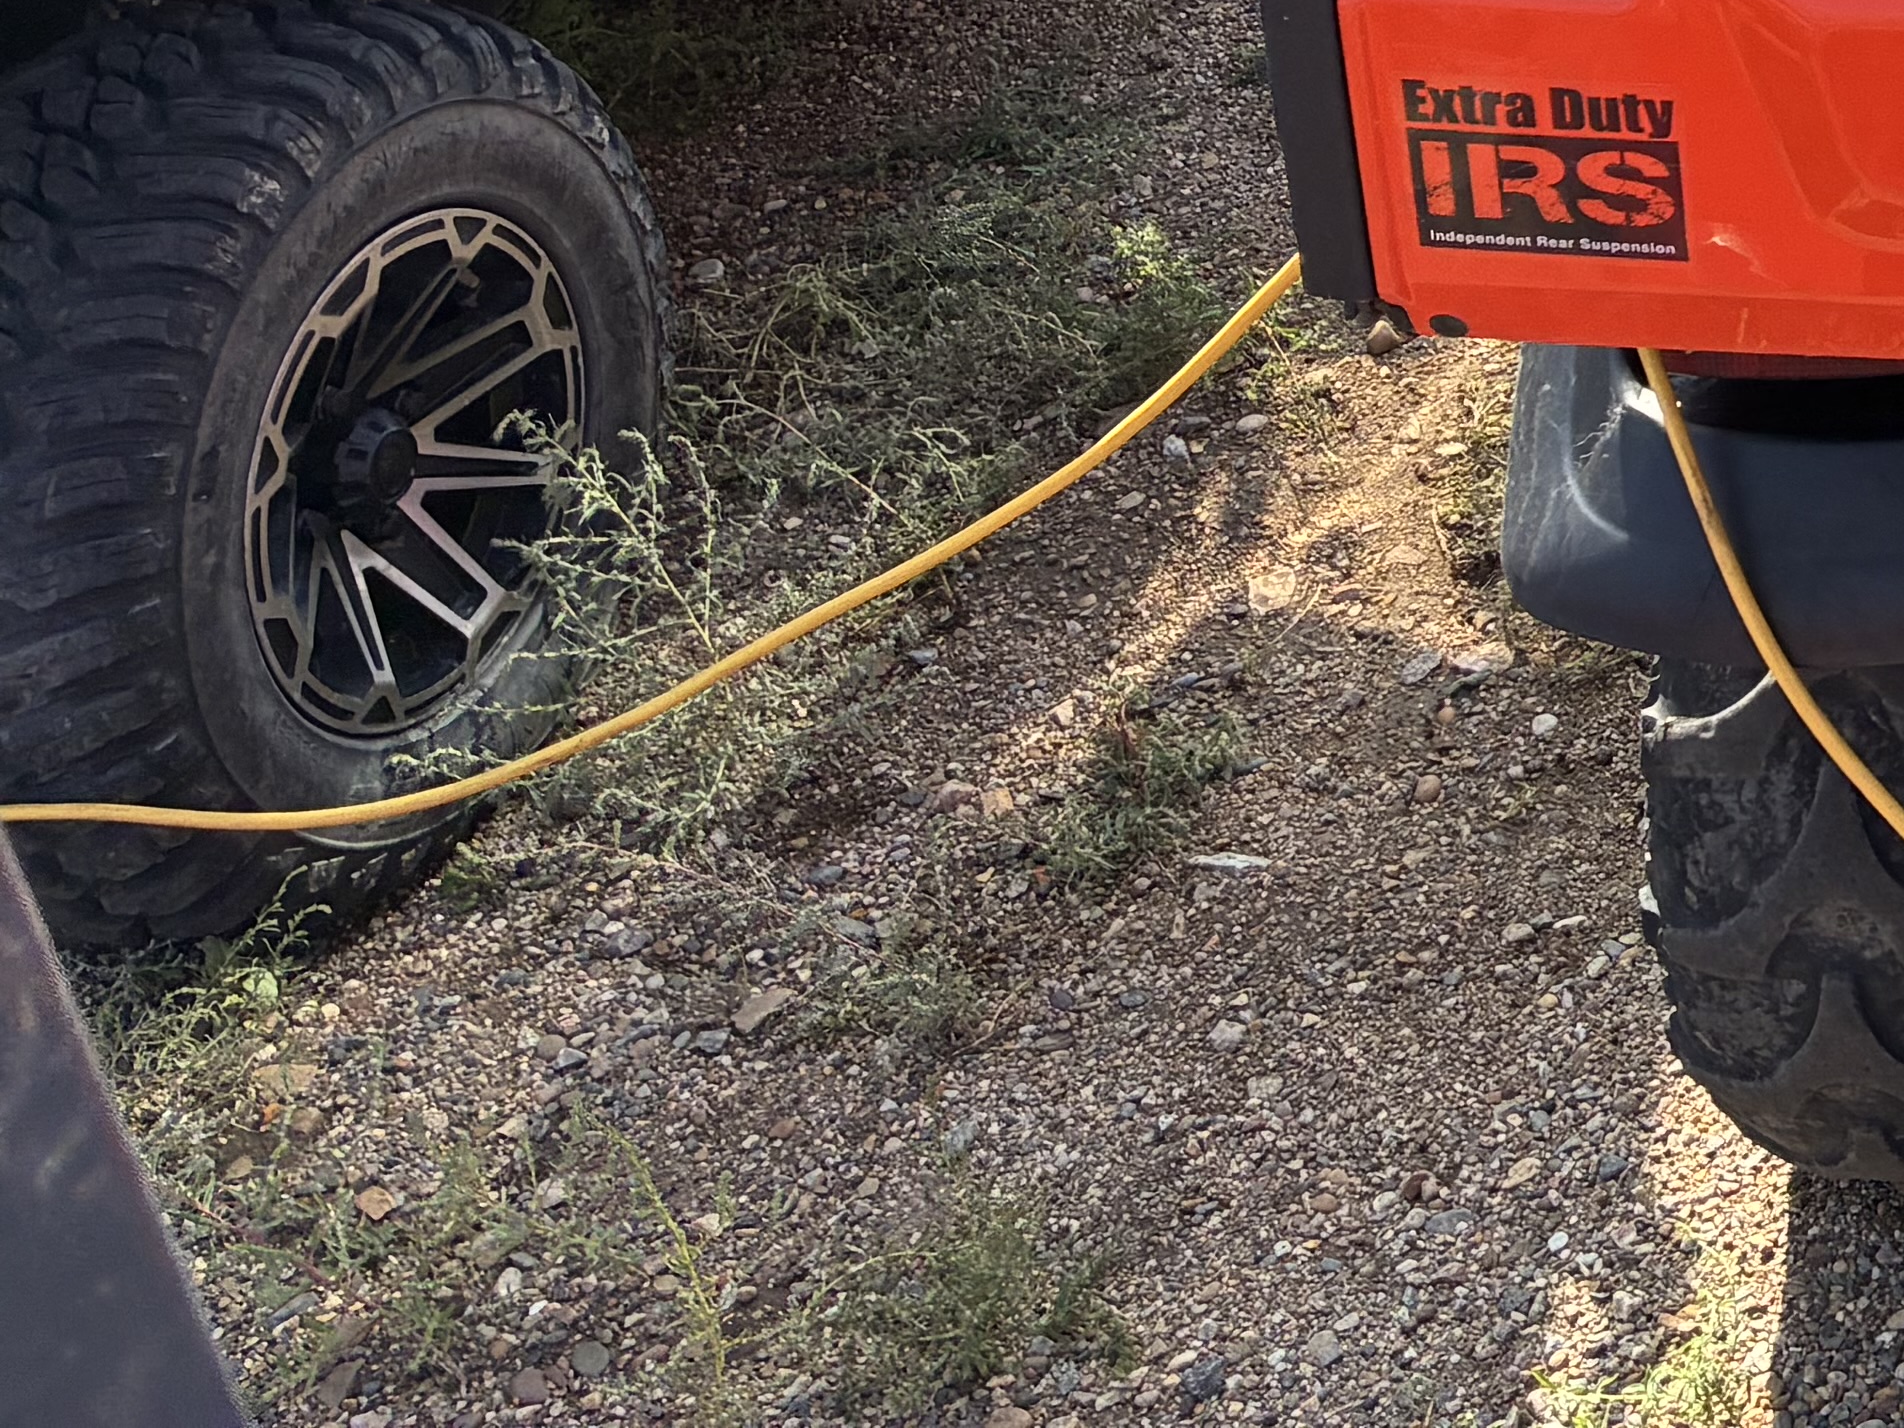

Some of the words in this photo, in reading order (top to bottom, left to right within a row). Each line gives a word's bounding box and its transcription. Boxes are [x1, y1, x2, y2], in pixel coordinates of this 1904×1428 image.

[1401, 78, 1537, 129] Extra
[1549, 87, 1674, 139] Duty
[1420, 140, 1676, 228] IRS
[1430, 229, 1532, 248] Independent
[1536, 235, 1574, 250] Rear
[1579, 237, 1677, 256] Suspension
